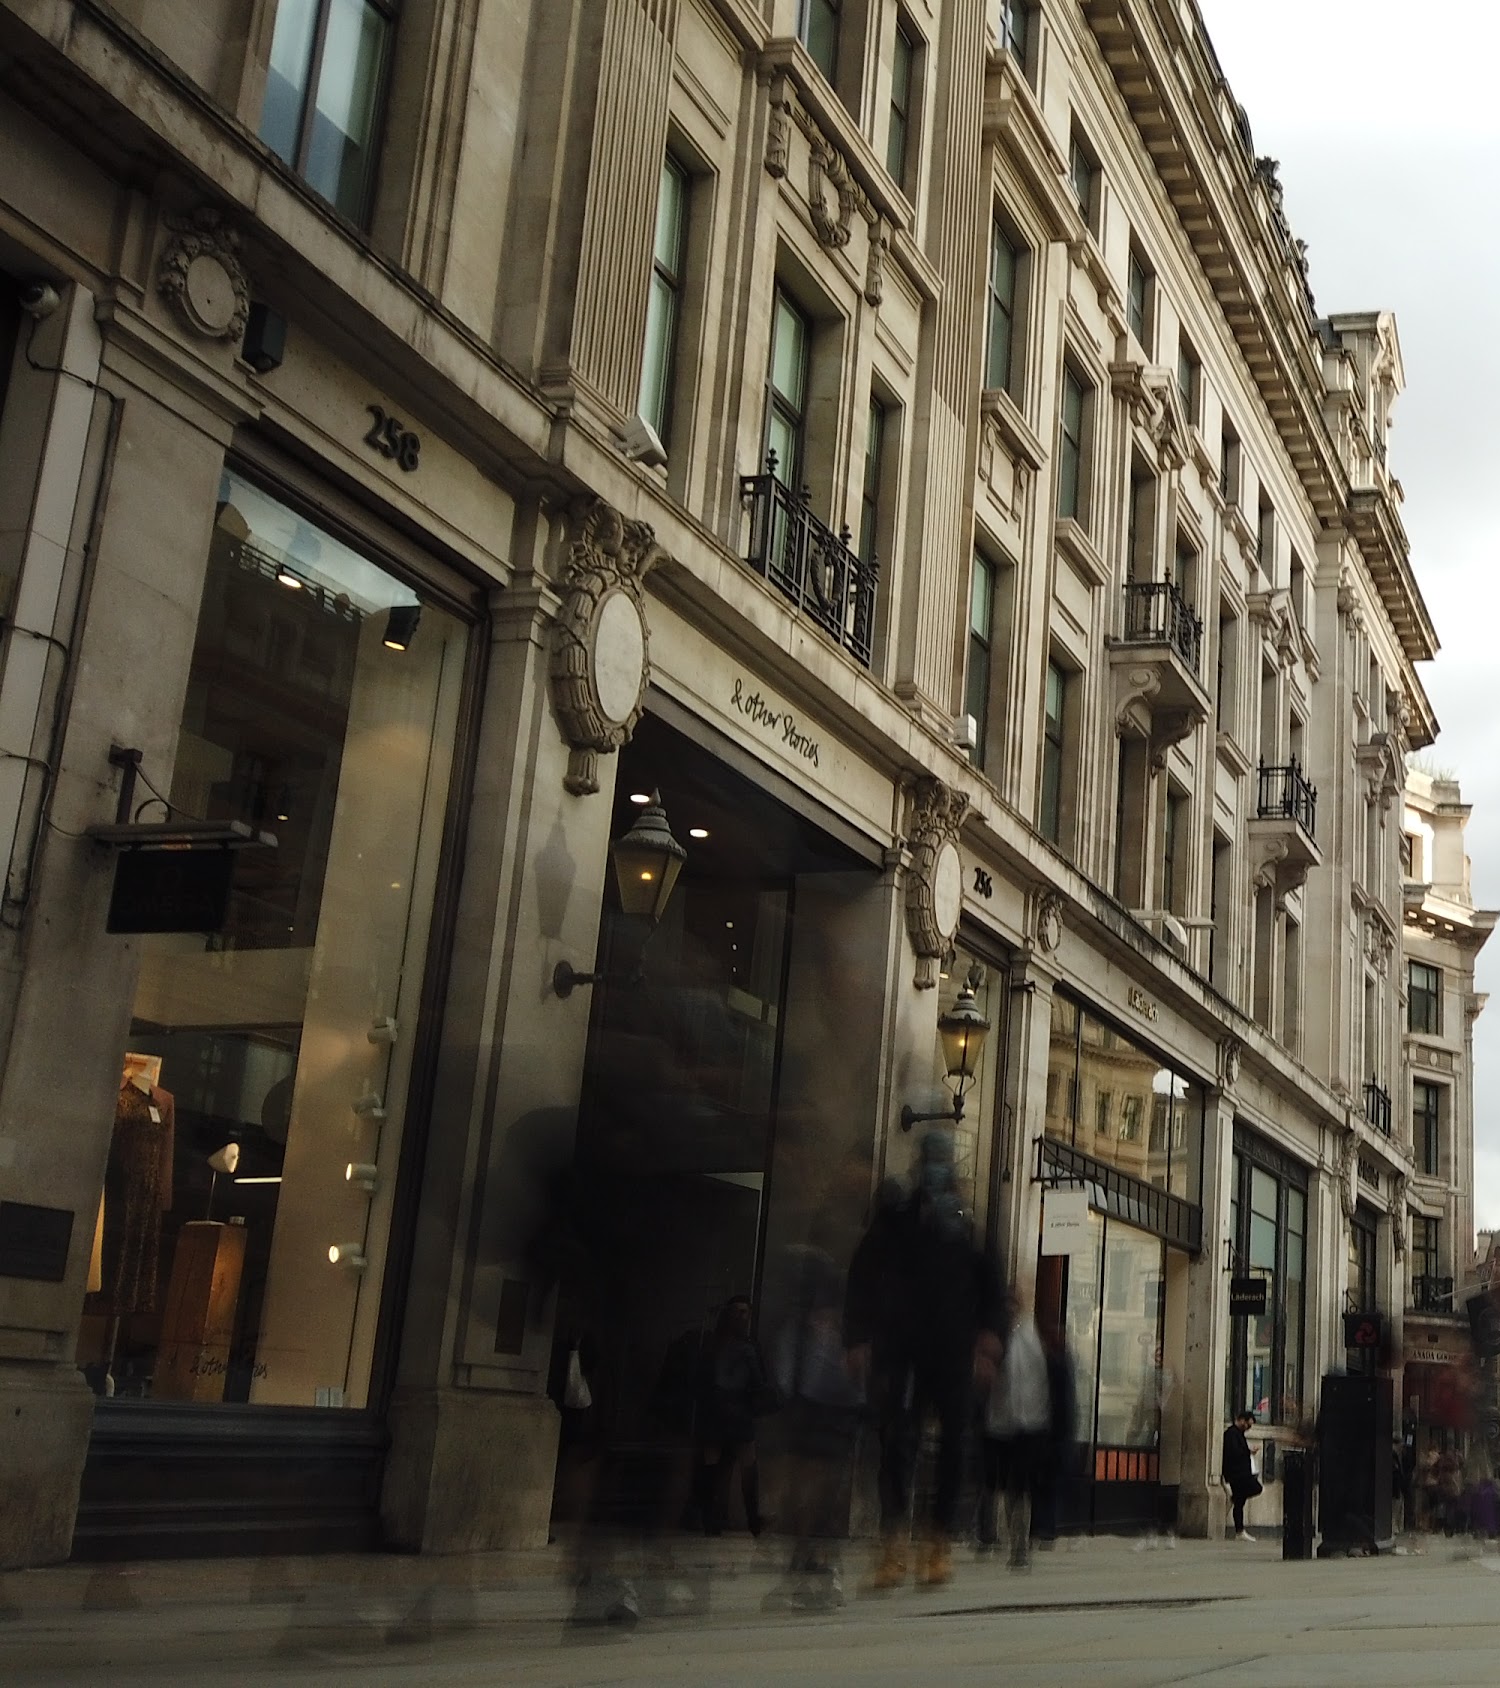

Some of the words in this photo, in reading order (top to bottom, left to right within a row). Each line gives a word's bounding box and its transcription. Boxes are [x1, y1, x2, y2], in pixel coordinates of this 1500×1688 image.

[362, 405, 421, 473] 258
[744, 692, 781, 729] other
[781, 714, 819, 769] Stories
[973, 867, 992, 899] 256
